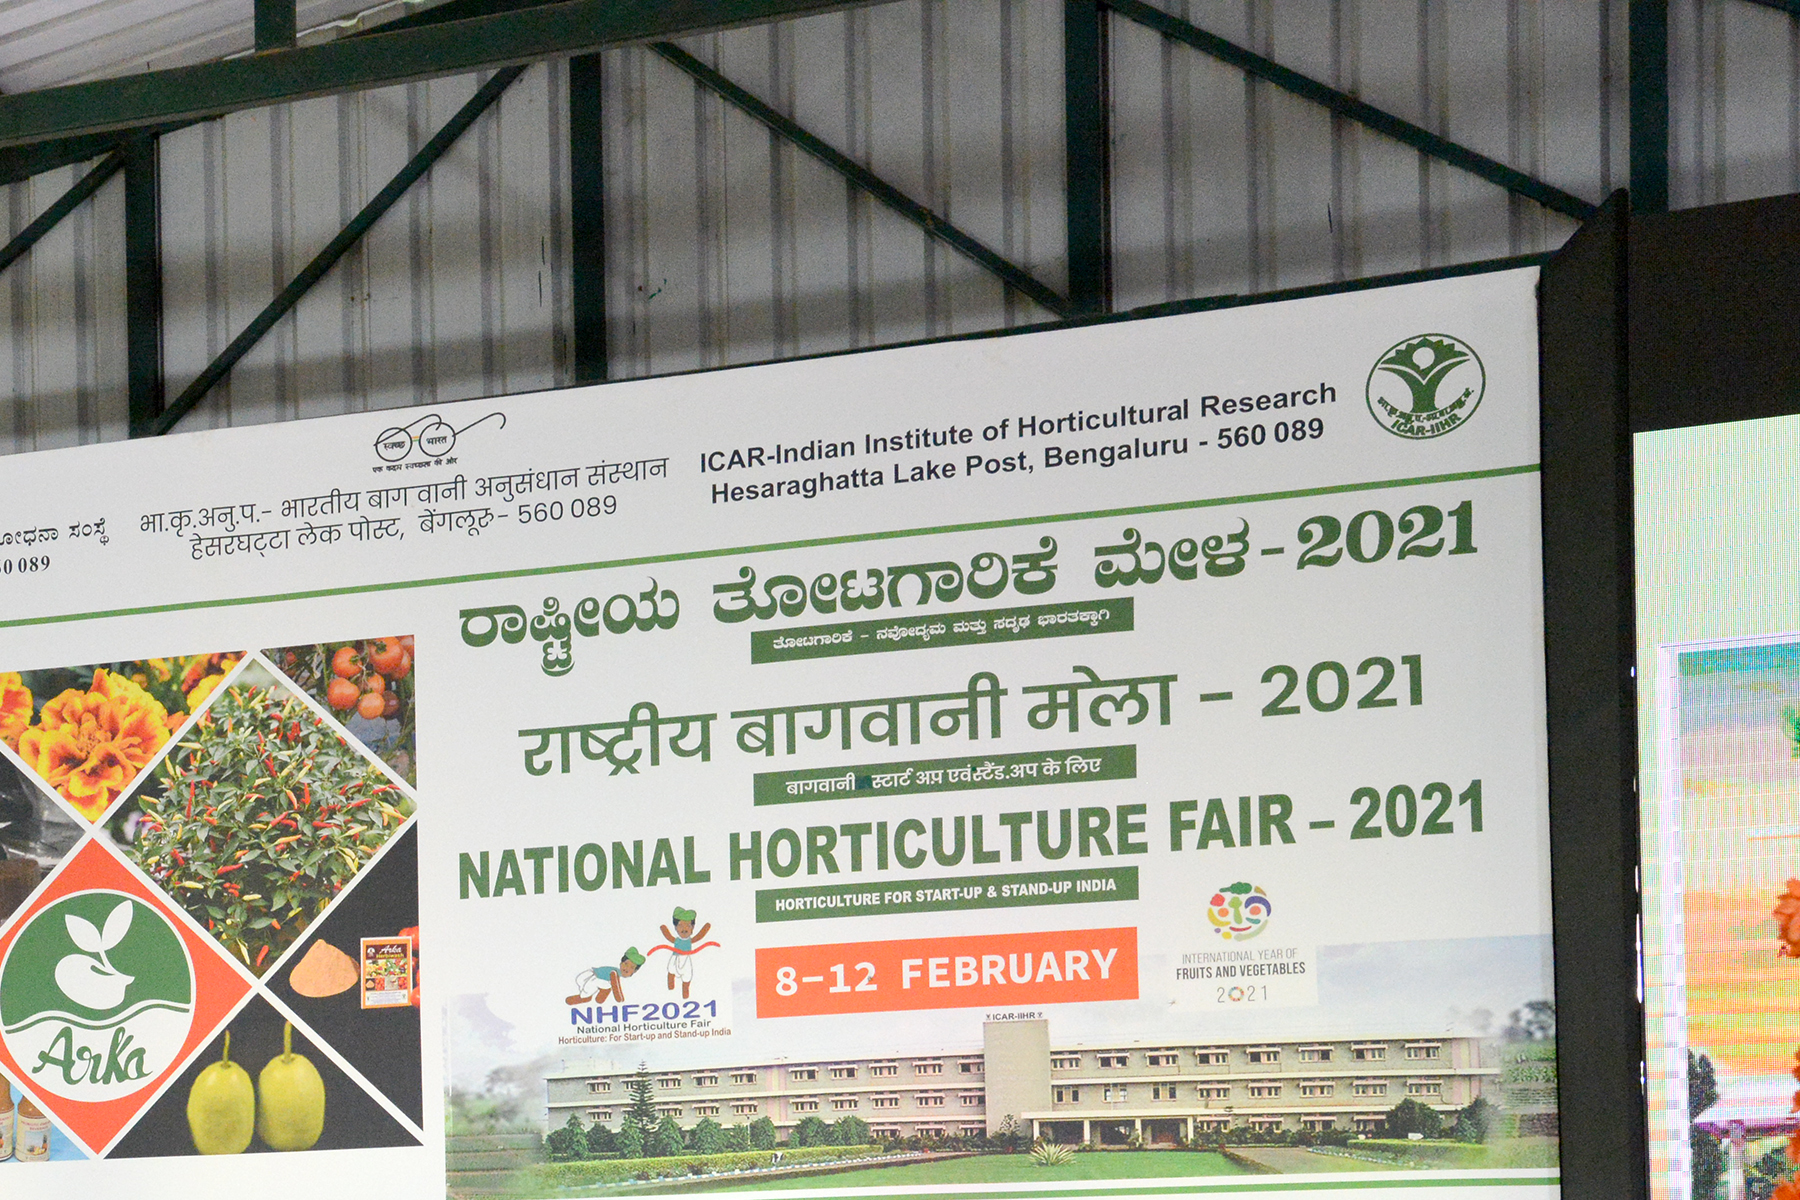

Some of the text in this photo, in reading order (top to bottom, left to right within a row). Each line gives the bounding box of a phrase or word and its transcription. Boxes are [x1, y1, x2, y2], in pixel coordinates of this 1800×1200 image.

[426, 436, 447, 445] भारत
[700, 434, 855, 473] ICAR-Indian
[864, 422, 973, 456] Institute
[983, 418, 1008, 442] of
[1018, 398, 1189, 438] Horticultural
[1201, 381, 1337, 417] Research
[711, 466, 885, 503] Hesaraghatta
[894, 458, 956, 485] Lake
[966, 451, 1034, 478] Post,
[1044, 434, 1188, 469] Bengaluru
[1217, 424, 1266, 450] 560
[1273, 417, 1324, 445] 089
[280, 489, 361, 517] भारतीय
[366, 474, 469, 509] बागवानी
[475, 469, 579, 499] अनुसंधान
[586, 456, 669, 487] संस्थान
[69, 518, 110, 546] ಸಂಸ್ಥೆ
[297, 522, 341, 546] लेक
[348, 512, 405, 542] पोस्ट,
[518, 502, 563, 523] 560
[570, 496, 617, 518] 089
[18, 556, 51, 574] 089
[459, 576, 680, 677] ರಾಷ್ಟ್ರೀಯ
[713, 536, 1057, 623] ತೋಟಗಾರಿಕೆ
[773, 629, 852, 649] ತೋಟಗಾರಿಕೆ
[876, 623, 946, 641] ನವೋದ್ಯಮ
[953, 618, 987, 635] ಮತ್ತು
[518, 701, 716, 777] राष्ट्रीय
[730, 671, 1007, 757] बागवानी
[1022, 665, 1177, 734] मेला
[1261, 654, 1422, 717] 2021
[786, 773, 855, 796] बागवानी
[872, 769, 913, 791] स्टार्ट
[1043, 753, 1062, 777] के
[1065, 749, 1101, 775] लिए
[459, 835, 711, 899] NATIONAL
[729, 803, 1147, 880] HORTICULTURE
[1169, 793, 1295, 852] FAIR
[1349, 779, 1483, 840] 2021
[776, 878, 1116, 912] HORTICULTURE FOR START-UP & STAND-UP INDIA
[902, 948, 1118, 990] FEBRUARY
[1176, 962, 1306, 980] FRUITS AND VEGETABLES
[1182, 948, 1298, 964] INTERNATIONAL YEAR OF
[1217, 985, 1267, 1003] 2021
[571, 1000, 717, 1025] NHF2021
[577, 1019, 711, 1034] National Horticulture Fair
[558, 1028, 732, 1045] Horticulture: For Start-up and Stand-up India
[32, 1027, 153, 1085] Arka
